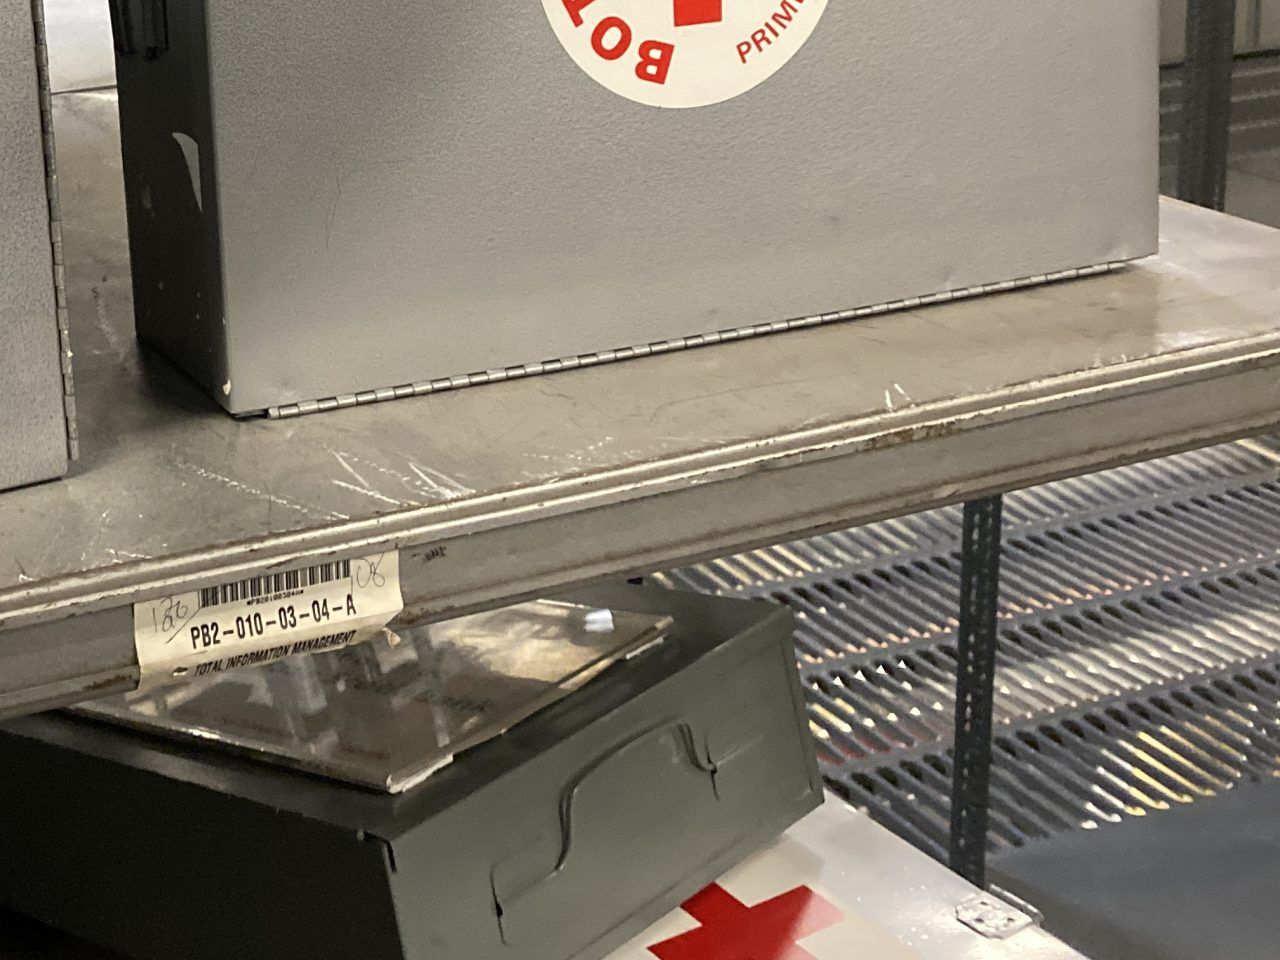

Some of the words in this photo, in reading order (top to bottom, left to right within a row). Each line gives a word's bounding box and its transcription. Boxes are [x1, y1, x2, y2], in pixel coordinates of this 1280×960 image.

[190, 593, 357, 650] PB2-010-03-04-A
[194, 659, 223, 677] TOTAL
[225, 644, 289, 670] INFORMATION
[291, 629, 357, 654] MANAGEMENT
